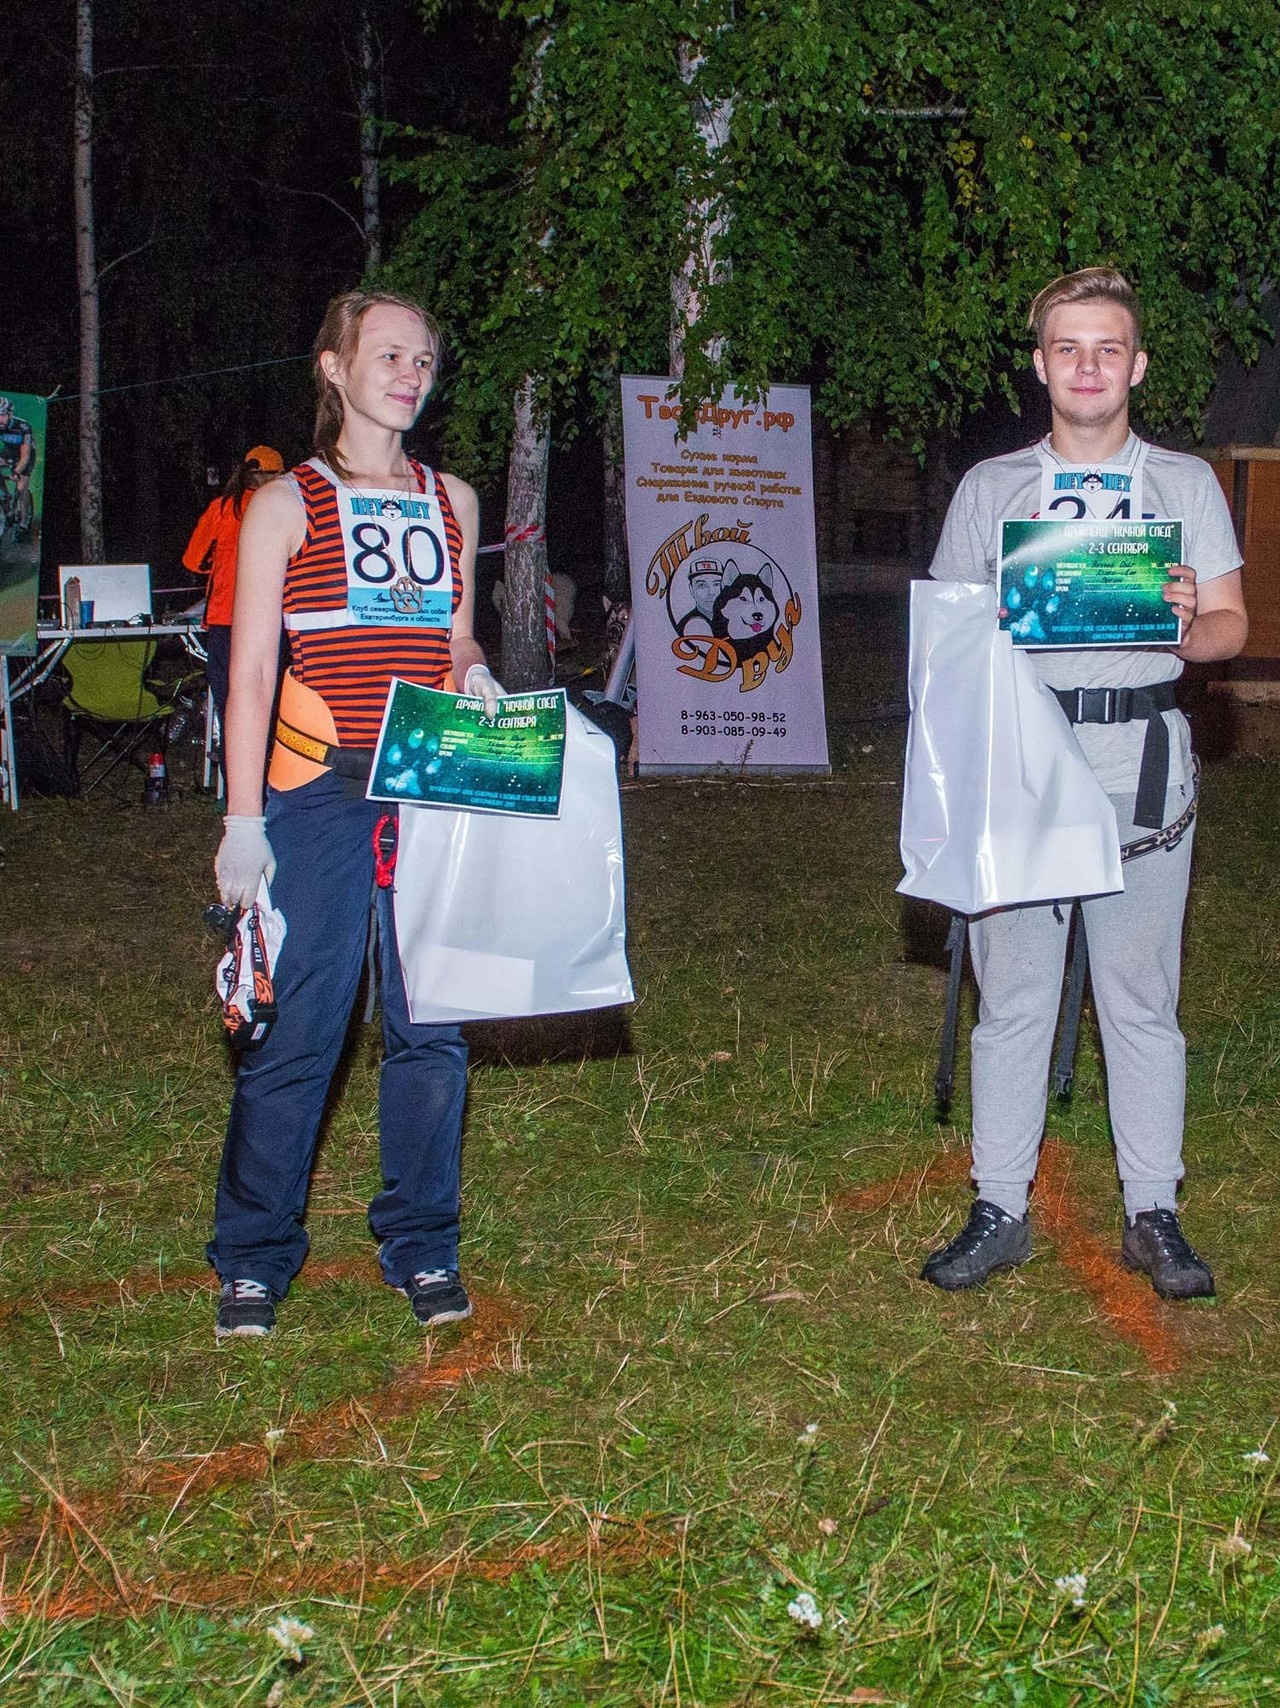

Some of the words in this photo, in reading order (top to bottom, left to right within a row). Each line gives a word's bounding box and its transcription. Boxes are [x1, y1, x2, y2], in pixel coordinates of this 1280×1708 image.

[637, 395, 795, 432] ТвоДруг.рф
[650, 462, 698, 476] Товары
[702, 466, 724, 476] для
[729, 468, 786, 480] животных
[714, 480, 756, 492] ручной
[1054, 473, 1085, 491] HEY
[1101, 473, 1133, 492] HEY
[656, 491, 680, 503] для
[743, 494, 784, 509] Спорта
[350, 497, 383, 516] HEY
[399, 499, 431, 520] HEY
[351, 522, 445, 586] 80
[1088, 542, 1105, 554] 2-3
[1107, 542, 1149, 555] СЕНТЯБРЯ
[455, 699, 500, 714] ДРАЙЛ
[478, 716, 496, 728] 2-3
[497, 715, 537, 729] СЕНТЯБРЯ
[680, 709, 786, 723] 8-963-050-98-52
[681, 725, 787, 738] 8-903-085-09-49
